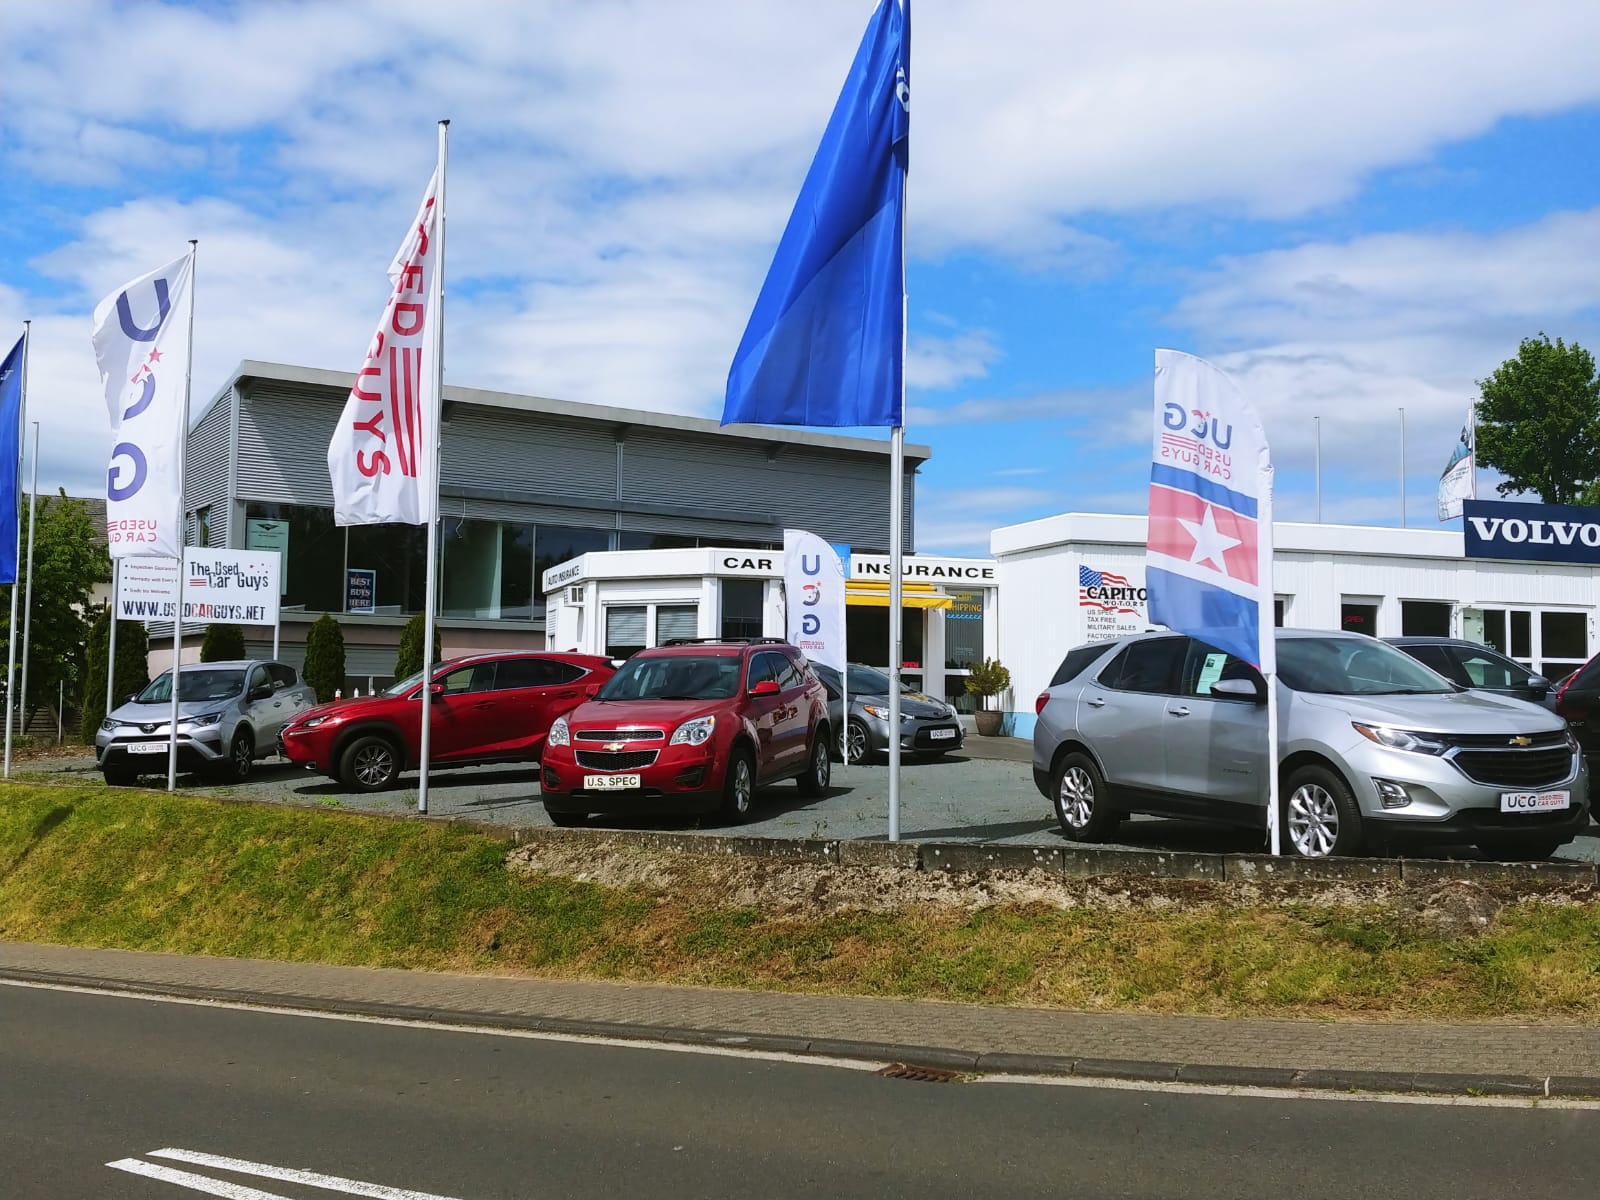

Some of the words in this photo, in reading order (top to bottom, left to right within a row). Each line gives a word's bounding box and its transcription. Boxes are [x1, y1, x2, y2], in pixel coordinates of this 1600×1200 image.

[1468, 516, 1600, 547] VOLVO
[190, 561, 210, 576] The
[215, 561, 239, 576] Used
[723, 557, 773, 570] CAR
[208, 571, 231, 588] Car
[237, 571, 269, 591] Guys
[1087, 586, 1147, 601] CAPITO
[123, 600, 266, 620] WWW.USDCARGUYS.NET
[948, 603, 982, 613] HIPPING
[587, 777, 606, 787] U.S.
[609, 776, 637, 786] SPEC
[1508, 794, 1536, 808] UCG
